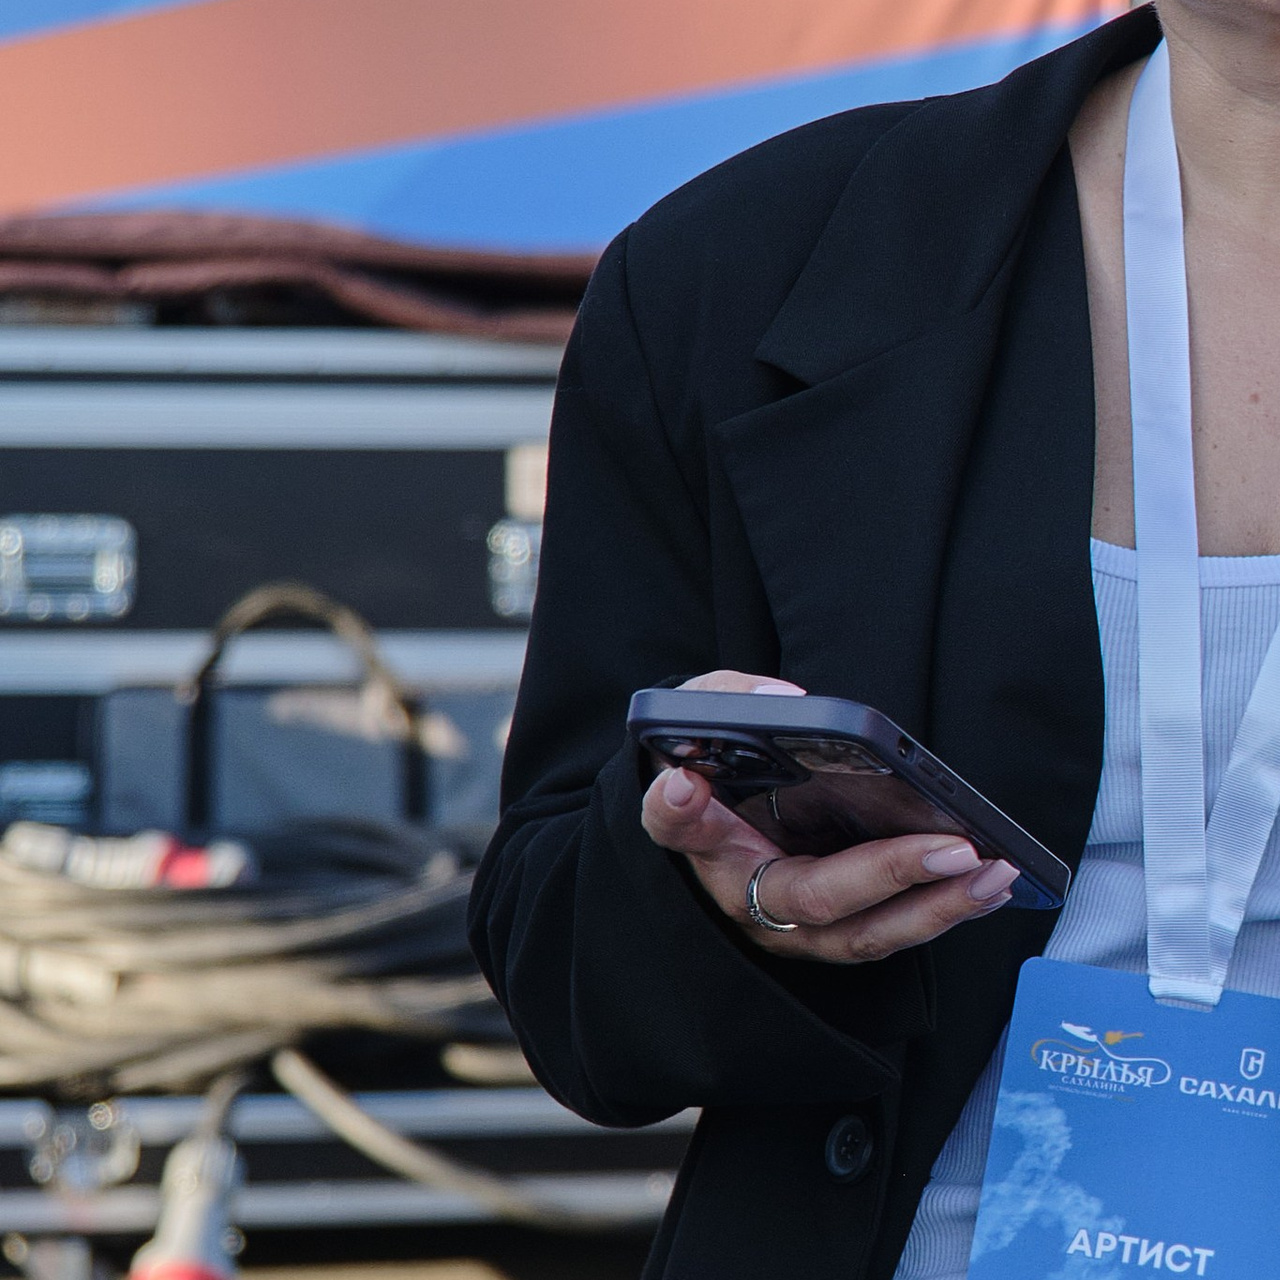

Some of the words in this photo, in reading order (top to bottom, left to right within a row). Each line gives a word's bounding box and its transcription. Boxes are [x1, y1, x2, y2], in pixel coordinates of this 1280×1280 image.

[1039, 1049, 1154, 1088] КРЫЛЬЯ
[1061, 1075, 1125, 1093] САХАЛИНА
[1066, 1228, 1215, 1277] АРТИСТ
